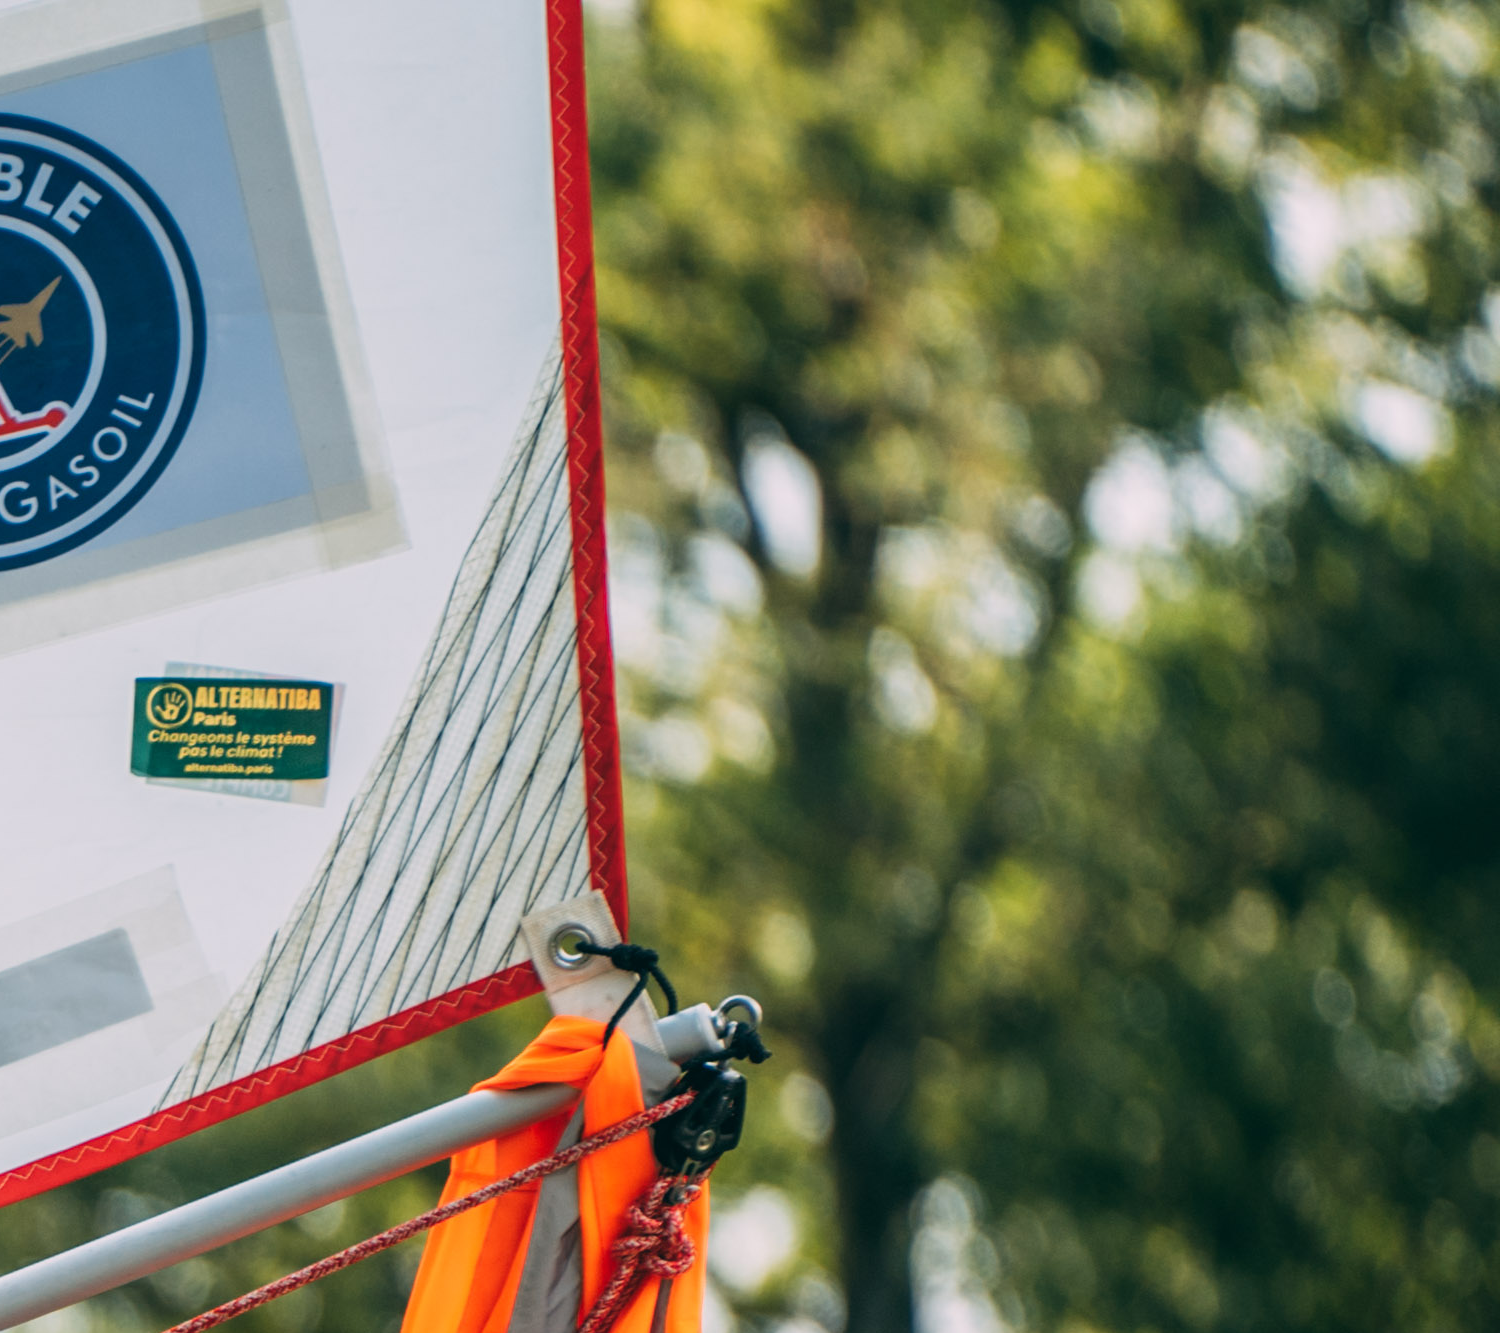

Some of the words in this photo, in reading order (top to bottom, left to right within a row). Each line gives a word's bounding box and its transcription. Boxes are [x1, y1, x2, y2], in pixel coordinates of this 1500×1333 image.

[194, 686, 321, 710] ALTERNATIBA
[192, 711, 237, 727] Paris
[147, 729, 234, 746] Changeons
[235, 731, 251, 744] le
[177, 746, 208, 760] pas
[209, 745, 225, 758] le
[226, 745, 275, 758] climat
